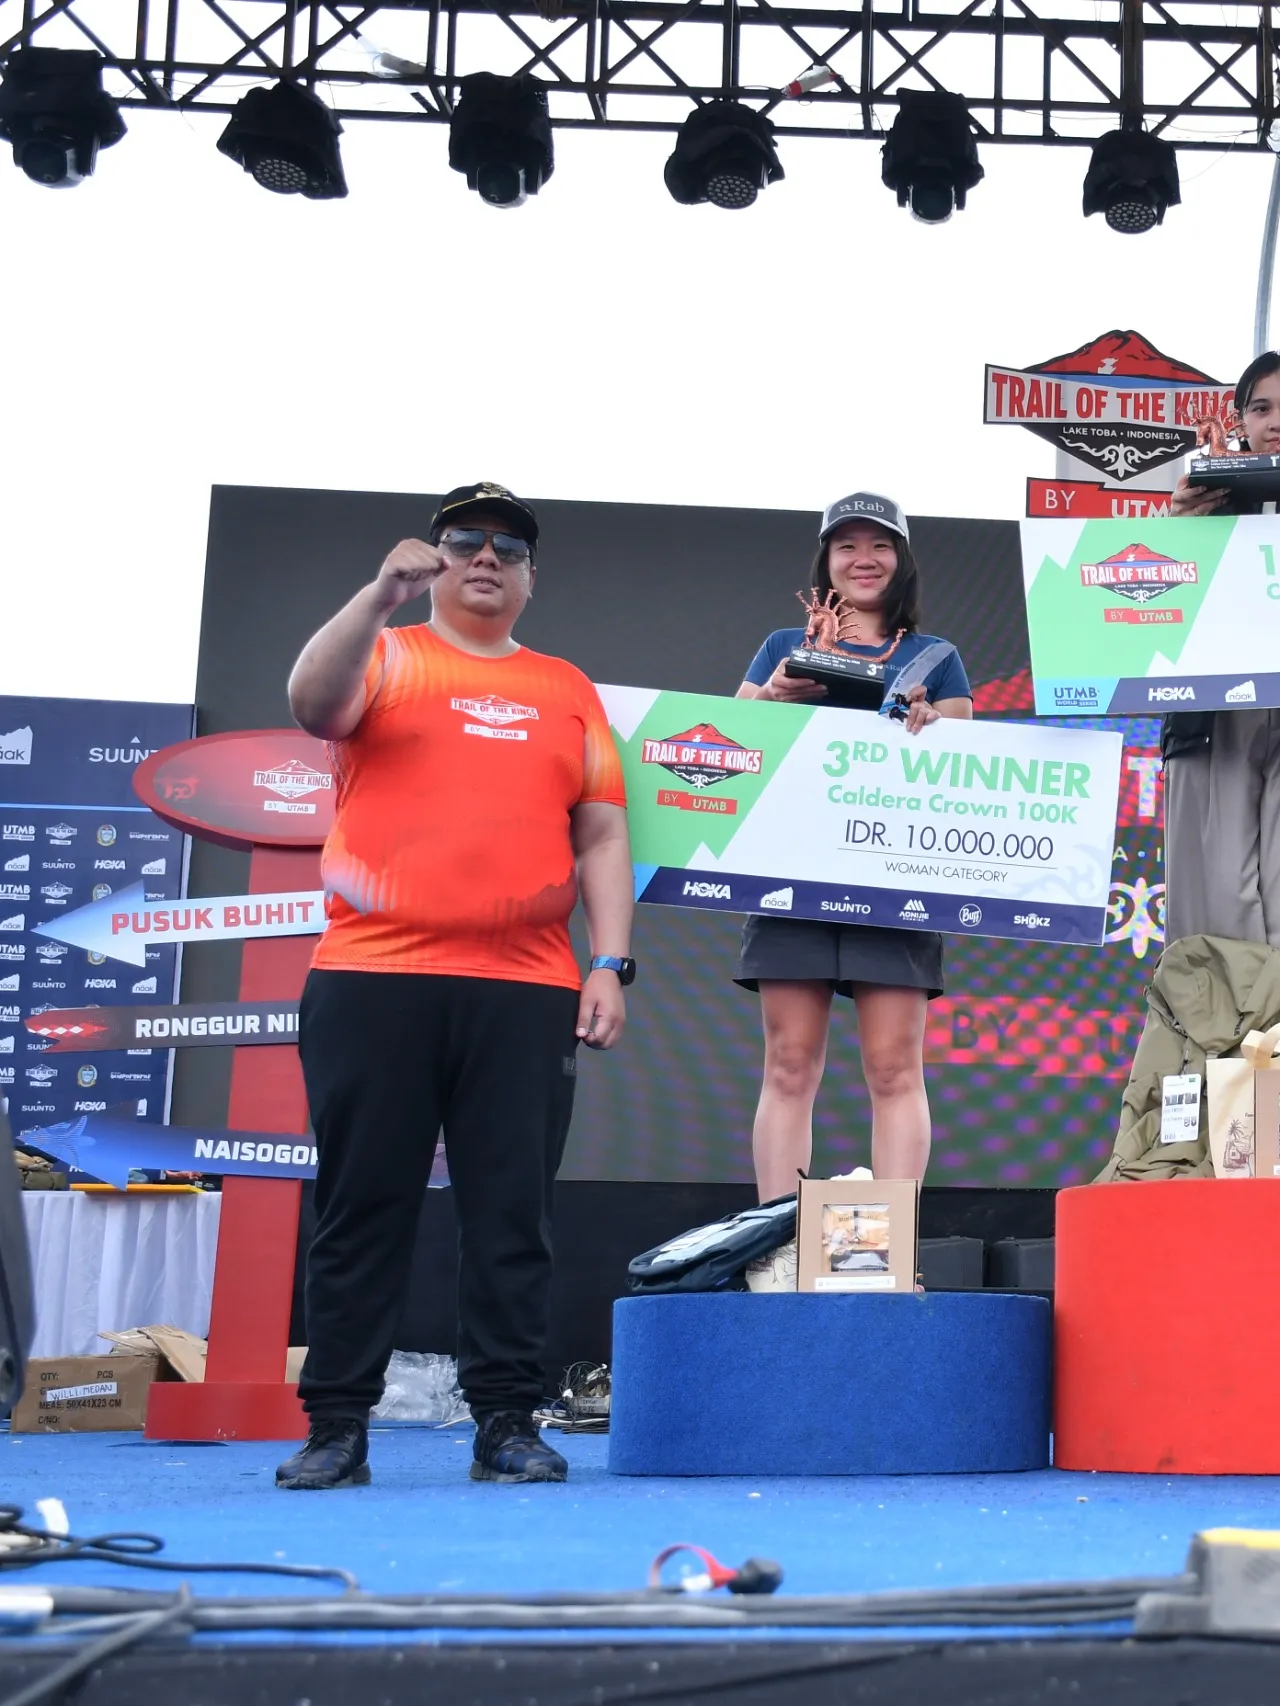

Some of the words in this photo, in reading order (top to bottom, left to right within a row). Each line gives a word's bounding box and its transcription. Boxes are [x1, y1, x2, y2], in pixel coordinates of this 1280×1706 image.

[992, 372, 1067, 419] TRAIL
[1076, 387, 1107, 418] OF
[1116, 391, 1165, 423] THE
[1174, 390, 1236, 430] KING
[1062, 425, 1088, 437] LAKE
[1091, 427, 1117, 438] TOBA
[1127, 430, 1181, 441] INDONESIA
[852, 500, 885, 513] Rab
[1045, 488, 1076, 511] BY
[1111, 498, 1170, 518] UTM
[1081, 566, 1116, 584] TRAIL
[1119, 565, 1134, 581] OF
[1136, 565, 1158, 580] THE
[1161, 563, 1197, 583] KINGS
[1110, 611, 1123, 620] BY
[1139, 612, 1173, 621] UTMB
[1054, 687, 1098, 699] UTMB
[1148, 687, 1196, 701] HOKA
[453, 699, 477, 711] TRAIL
[480, 705, 490, 713] OF
[511, 708, 538, 718] KINGS
[493, 730, 519, 738] UTMB
[89, 747, 159, 763] SUUN
[645, 741, 678, 762] TRAIL
[681, 746, 697, 763] OF
[700, 750, 722, 766] THE
[724, 750, 761, 773] KINGS
[822, 740, 889, 778] 3RD
[900, 747, 1091, 799] WINNER
[256, 772, 277, 784] TRAIL
[279, 775, 289, 784] OF
[292, 776, 305, 784] THE
[307, 775, 331, 787] KINGS
[664, 793, 679, 803] BY
[692, 798, 727, 811] UTMB
[827, 784, 922, 812] Caldera
[928, 793, 1008, 819] Crown
[1017, 801, 1079, 825] 100K
[3, 825, 35, 834] UTMB
[844, 819, 893, 848] IDR.
[907, 824, 1054, 861] 10.000.000
[94, 860, 126, 869] HOKA
[885, 860, 940, 877] WOMAN
[942, 866, 1008, 883] CATEGORY
[683, 881, 731, 900] HOKA
[821, 900, 871, 915] SUUNTO
[111, 907, 214, 935] PUSUK
[223, 901, 315, 928] BUHIT
[1014, 913, 1051, 928] SHOKZ
[84, 979, 117, 988] HOKA
[135, 1014, 260, 1038] RONGGUR
[74, 1102, 107, 1111] HOKA
[97, 1370, 113, 1379] PCS
[108, 1399, 121, 1408] CM
